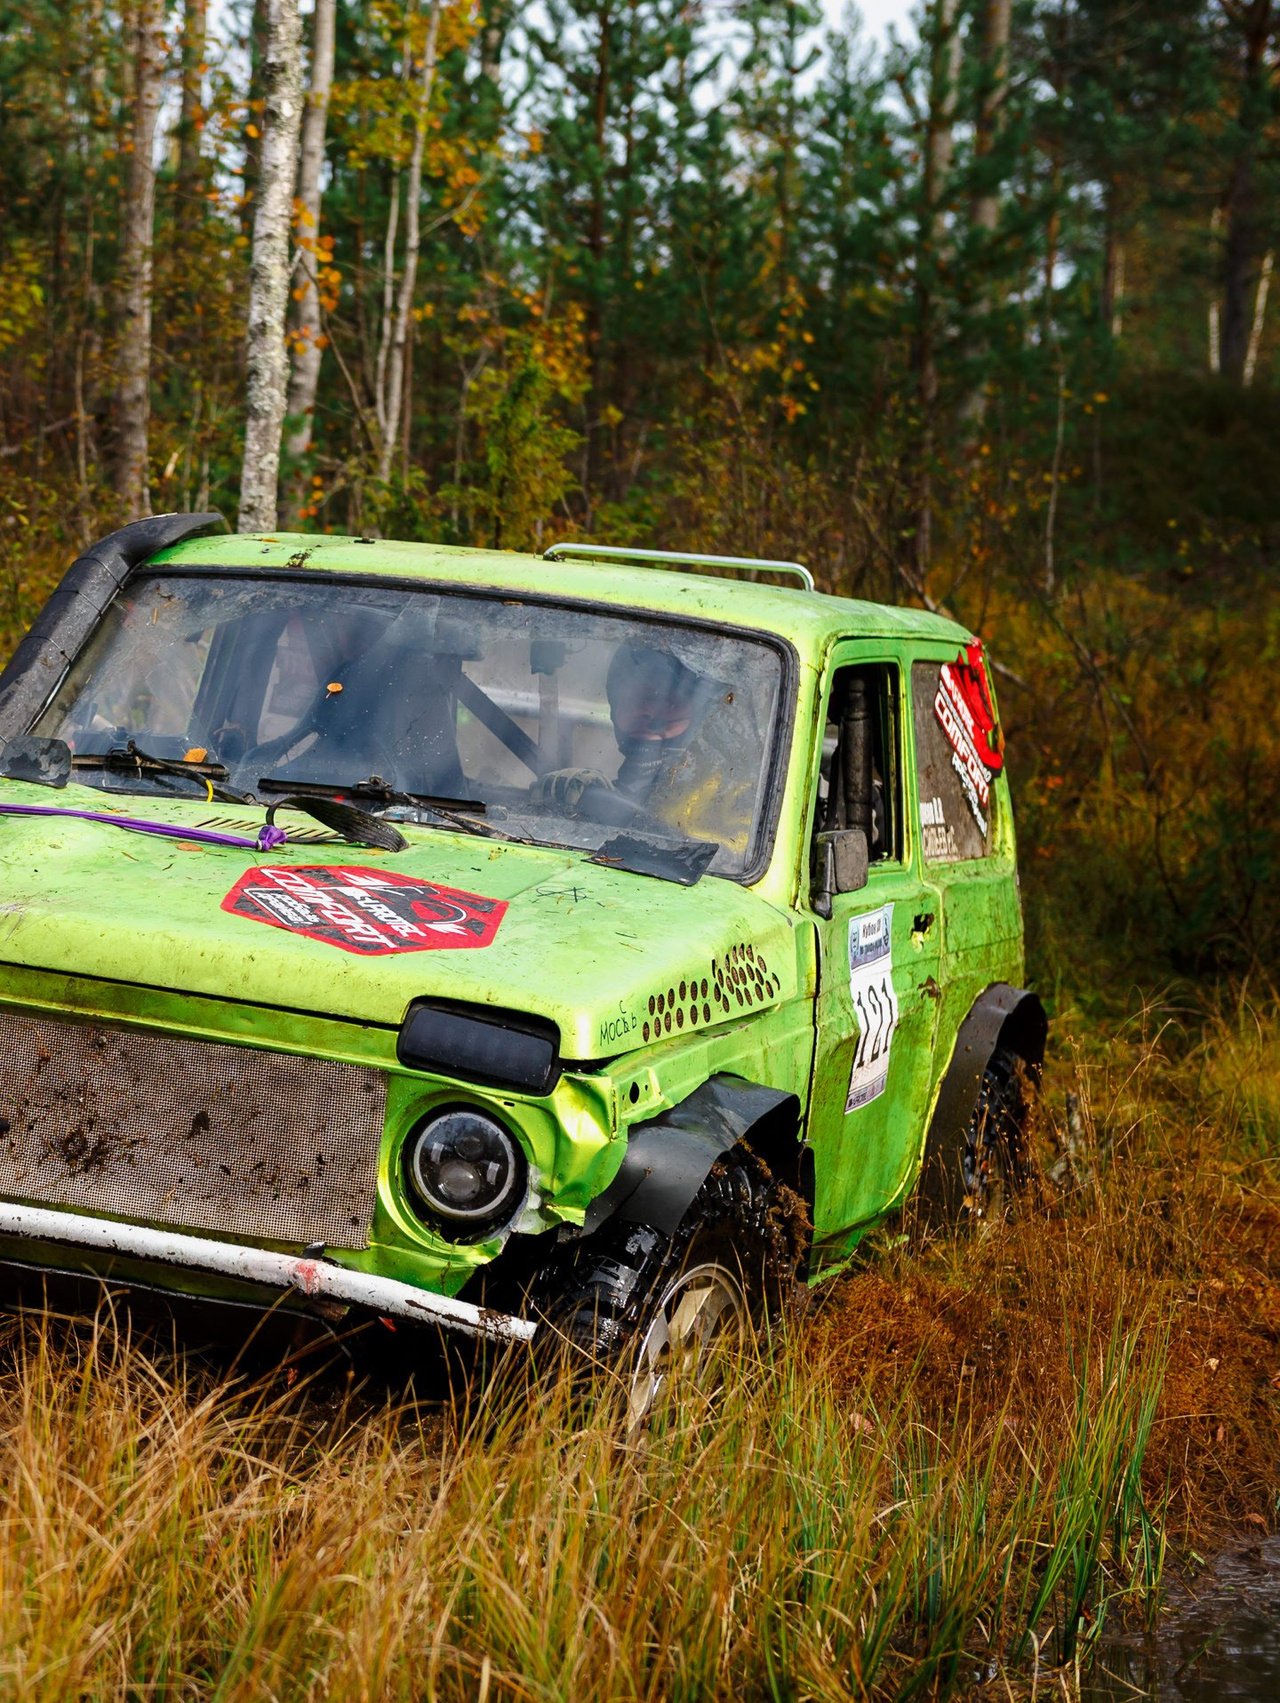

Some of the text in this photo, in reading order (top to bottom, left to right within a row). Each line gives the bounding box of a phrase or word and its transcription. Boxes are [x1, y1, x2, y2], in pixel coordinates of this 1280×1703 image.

[935, 691, 989, 802] COMFORT
[260, 868, 398, 949] COMFORT
[857, 978, 893, 1069] 121
